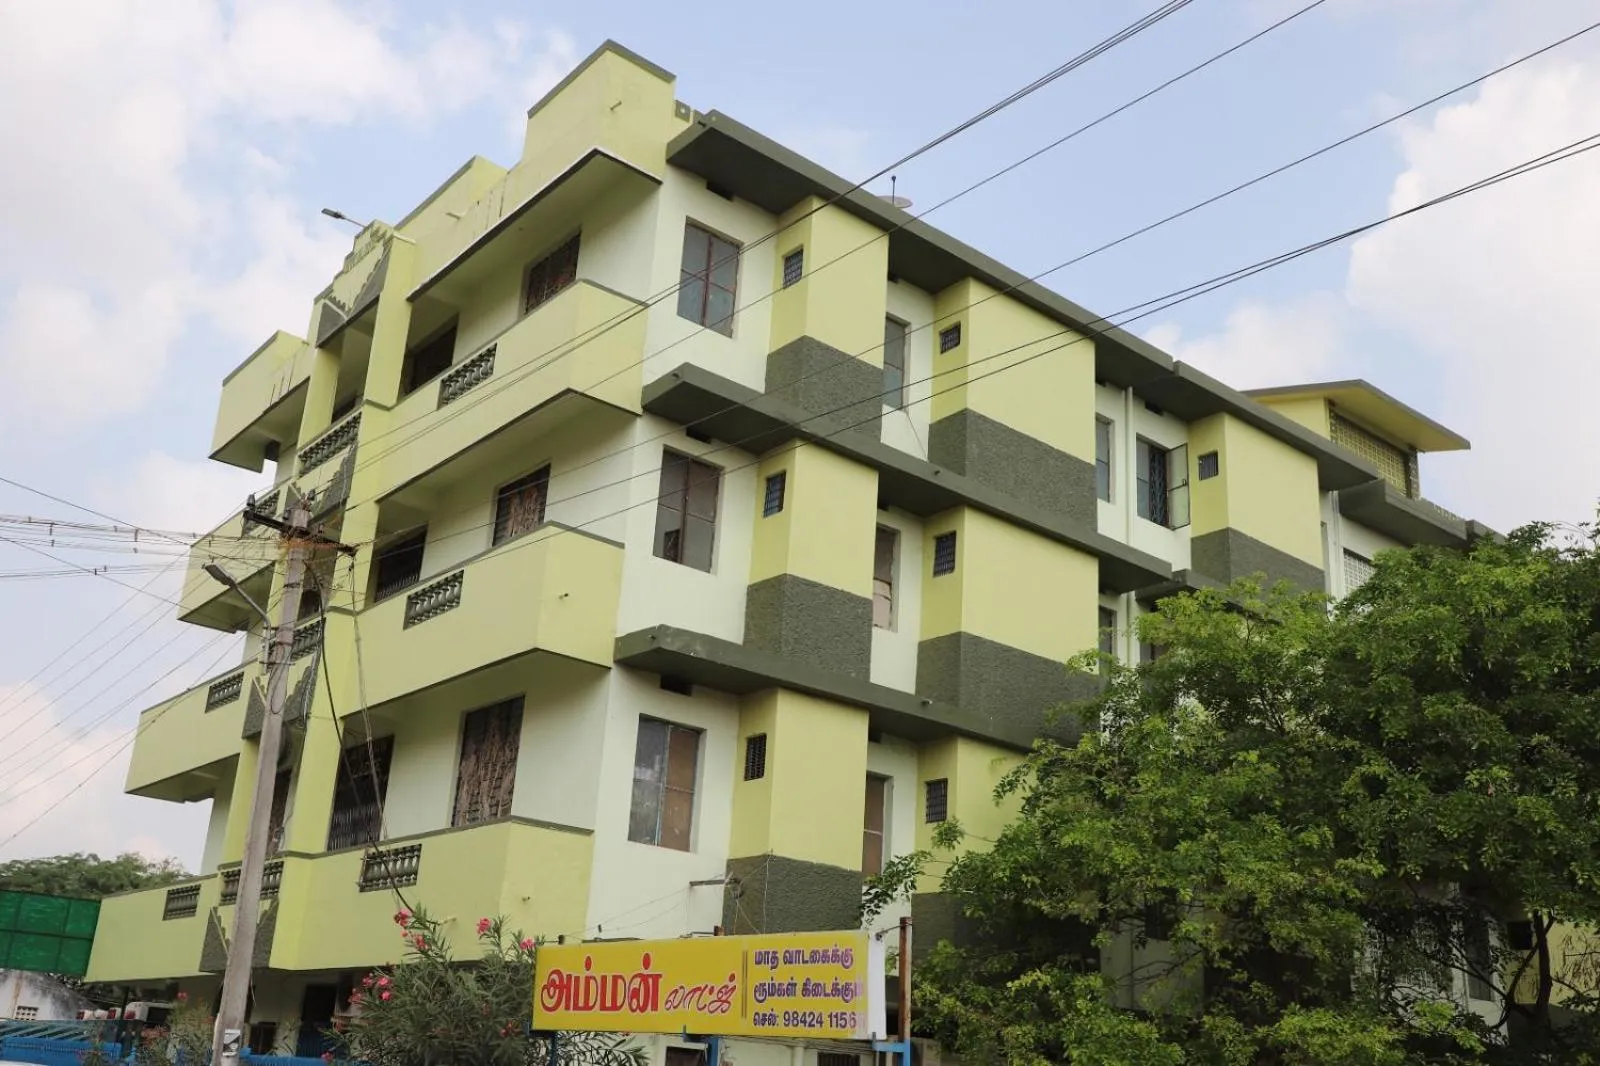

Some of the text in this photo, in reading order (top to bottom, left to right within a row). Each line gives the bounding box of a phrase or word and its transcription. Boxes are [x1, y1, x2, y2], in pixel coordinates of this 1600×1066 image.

[754, 943, 854, 970] மாத வாடகைக்கு
[541, 953, 737, 1014] அம்மன் லாட்ஜ்
[754, 976, 798, 1003] ரூம்கள்
[753, 1008, 866, 1029] செல்: 98424 1156
